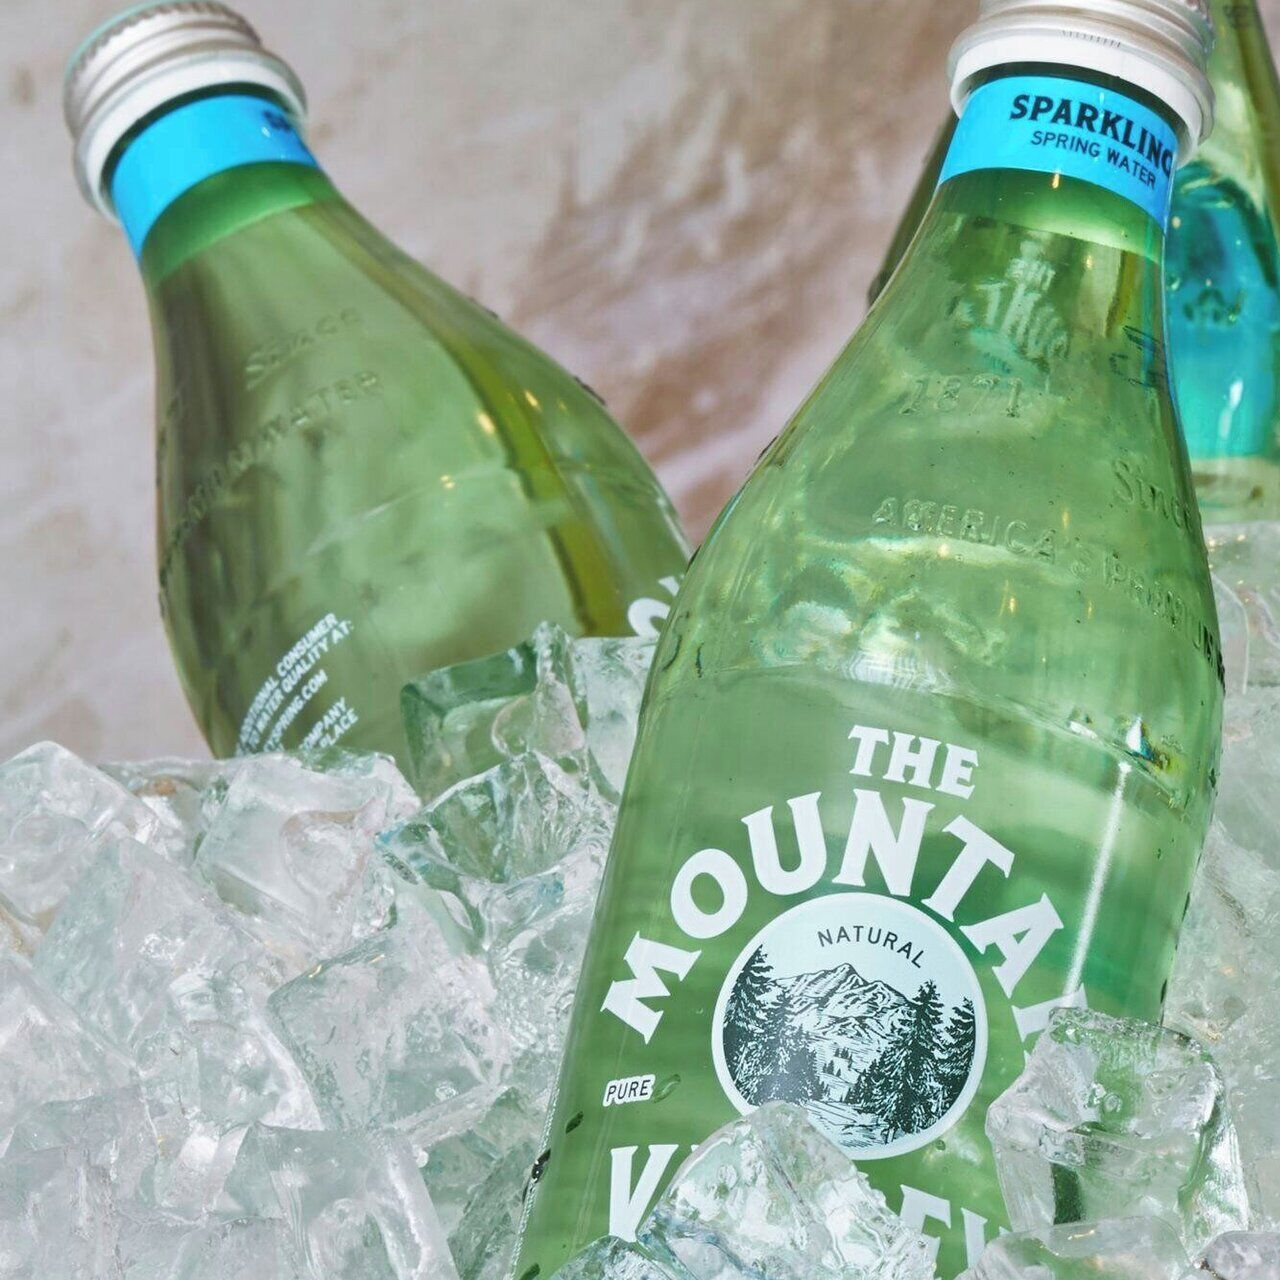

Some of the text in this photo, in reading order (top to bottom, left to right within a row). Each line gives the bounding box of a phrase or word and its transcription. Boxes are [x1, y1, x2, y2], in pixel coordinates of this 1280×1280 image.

[1030, 130, 1157, 190] SPRING WATER
[277, 612, 339, 677] CONSUMER
[281, 635, 329, 693] QUALITY
[847, 724, 980, 799] THE
[601, 789, 1089, 1061] MOUNTAI
[817, 925, 925, 968] NATURAL
[606, 1080, 650, 1101] PURE
